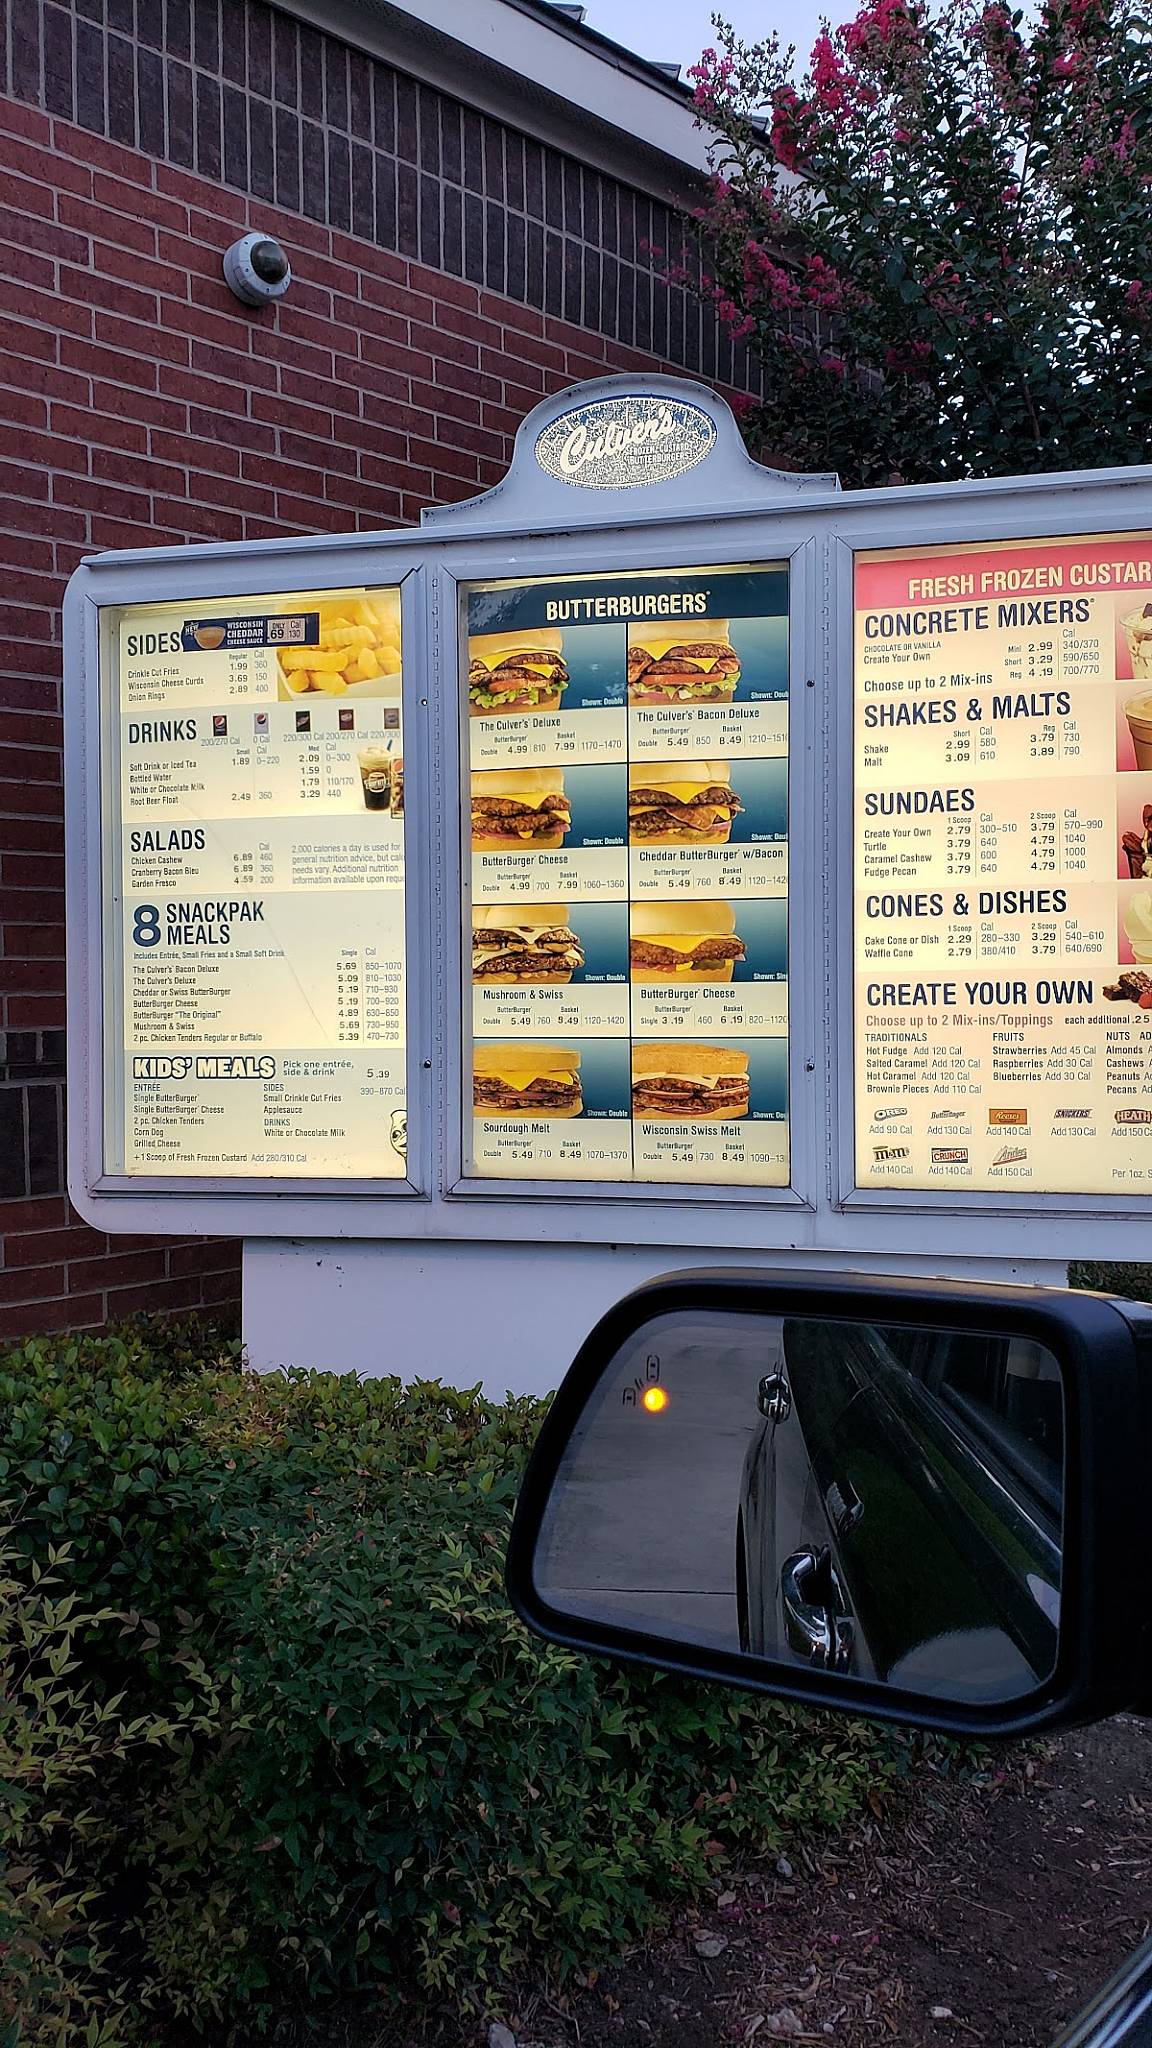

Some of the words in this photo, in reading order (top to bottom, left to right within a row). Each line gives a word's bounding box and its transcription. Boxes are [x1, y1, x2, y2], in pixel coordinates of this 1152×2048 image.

[909, 576, 973, 600] FRESH
[982, 567, 1062, 592] FROZEN
[227, 621, 263, 630] WISCONSIN
[865, 606, 989, 638] CONCRETE
[227, 629, 263, 638] CHEDDAR
[127, 632, 180, 656] SIDES
[864, 654, 889, 664] Create
[892, 654, 909, 662] Your
[913, 653, 930, 661] Own
[1028, 642, 1052, 651] 2.99
[1063, 640, 1099, 649] 340/370
[1028, 655, 1052, 664] 3.29
[1063, 653, 1099, 662] 590/650
[230, 663, 248, 671] 1.99
[128, 680, 160, 690] Wisconsin
[161, 679, 183, 687] Cheese
[185, 677, 203, 686] Curds
[229, 675, 248, 683] 3.69
[864, 681, 904, 692] Choose
[908, 680, 921, 692] up
[926, 678, 935, 688] to
[940, 676, 946, 687] 2
[950, 674, 992, 686] Mix-ins
[229, 685, 248, 694] 2.89
[637, 712, 652, 722] The
[697, 710, 726, 720] Bacon
[728, 708, 759, 719] Deluxe
[864, 700, 956, 727] SHAKES
[966, 699, 982, 721] &
[993, 692, 1070, 719] MALTS
[479, 722, 494, 731] The
[533, 718, 561, 728] Deluxe
[129, 720, 197, 744] DRINKS
[667, 737, 688, 746] 5.49
[719, 736, 741, 744] 8.49
[864, 745, 889, 754] Shake
[946, 740, 970, 749] 2.99
[980, 738, 996, 747] 580
[1030, 733, 1054, 742] 3.79
[1064, 733, 1080, 741] 730
[508, 745, 528, 753] 4.99
[555, 742, 575, 751] 7.99
[299, 754, 319, 763] 2.09
[864, 758, 882, 766] Malt
[946, 753, 970, 762] 3.09
[980, 751, 995, 760] 610
[1031, 747, 1054, 756] 3.89
[1064, 746, 1080, 755] 790
[130, 774, 151, 783] Bottled
[153, 773, 171, 782] Water
[302, 766, 320, 774] 1.59
[302, 778, 320, 786] 1.79
[231, 792, 251, 801] 2.49
[300, 790, 320, 798] 3.29
[865, 789, 975, 816] SUNDAES
[130, 829, 205, 852] SALADS
[864, 842, 887, 851] Turtle
[947, 839, 971, 847] 3.79
[1030, 836, 1054, 845] 4.79
[131, 856, 156, 865] Chicken
[158, 855, 183, 864] Cashew
[233, 853, 252, 862] 6.89
[538, 855, 568, 864] Cheese
[639, 851, 676, 861] Cheddar
[743, 849, 783, 860] w/Bacon
[864, 854, 897, 863] Caramel
[900, 853, 932, 862] Cashew
[864, 868, 889, 878] Fudge
[892, 866, 916, 876] Pecan
[510, 882, 530, 890] 4.99
[558, 881, 577, 889] 7.99
[669, 879, 690, 888] 5.49
[719, 877, 741, 885] 8.49
[866, 893, 943, 918] CONES
[953, 893, 969, 915] &
[979, 889, 1067, 915] DISHES
[166, 901, 264, 923] SNACKPAK
[132, 904, 161, 947] 8
[167, 924, 230, 946] MEALS
[948, 935, 972, 944] 2.29
[1032, 932, 1056, 941] 3.29
[948, 947, 971, 956] 2.79
[1032, 945, 1056, 954] 3.79
[336, 962, 356, 970] 5.69
[338, 974, 358, 982] 5.09
[483, 990, 527, 1000] Mushroom
[530, 990, 536, 999] &
[538, 990, 563, 1000] Swiss
[703, 988, 735, 998] Cheese
[867, 983, 956, 1006] CREATE
[965, 981, 1027, 1005] YOUR
[1036, 980, 1093, 1004] OWN
[338, 1009, 359, 1017] 4.89
[176, 1022, 195, 1030] Swiss
[339, 1021, 359, 1029] 5.69
[511, 1017, 531, 1025] 5.49
[866, 1015, 906, 1026] Choose
[910, 1015, 923, 1027] up
[928, 1014, 937, 1025] to
[942, 1015, 948, 1025] 2
[953, 1014, 1053, 1026] Mix-ins/Toppings
[1065, 1016, 1084, 1024] each
[1088, 1015, 1130, 1024] additional
[338, 1033, 359, 1041] 5.39
[865, 1033, 927, 1042] TRADITIONALS
[993, 1032, 1024, 1041] FRUITS
[1106, 1032, 1130, 1041] NUTS
[993, 1046, 1047, 1055] Strawberries
[1106, 1045, 1143, 1054] Almonds
[134, 1057, 192, 1078] KIDS'
[197, 1056, 275, 1079] MEALS
[283, 1060, 301, 1068] Pick
[993, 1059, 1044, 1068] Raspberries
[1106, 1059, 1144, 1068] Cashews
[283, 1068, 301, 1076] side
[312, 1068, 335, 1076] drink
[993, 1072, 1041, 1081] Blueberries
[1106, 1072, 1140, 1081] Peanuts
[1107, 1085, 1137, 1094] Pecans
[264, 1106, 302, 1114] Applesauce
[874, 1107, 907, 1121] OREO
[1117, 1112, 1151, 1122] HEATH
[151, 1129, 163, 1137] Dog
[484, 1123, 529, 1134] Sourdough
[531, 1123, 550, 1133] Melt
[642, 1124, 688, 1135] Wisconsin
[691, 1125, 718, 1136] Swiss
[721, 1126, 741, 1136] Melt
[512, 1150, 533, 1158] 5.49
[559, 1150, 581, 1158] 8.49
[672, 1153, 693, 1162] 5.49
[722, 1153, 744, 1161] 8.49
[934, 1151, 966, 1161] CRUNCH
